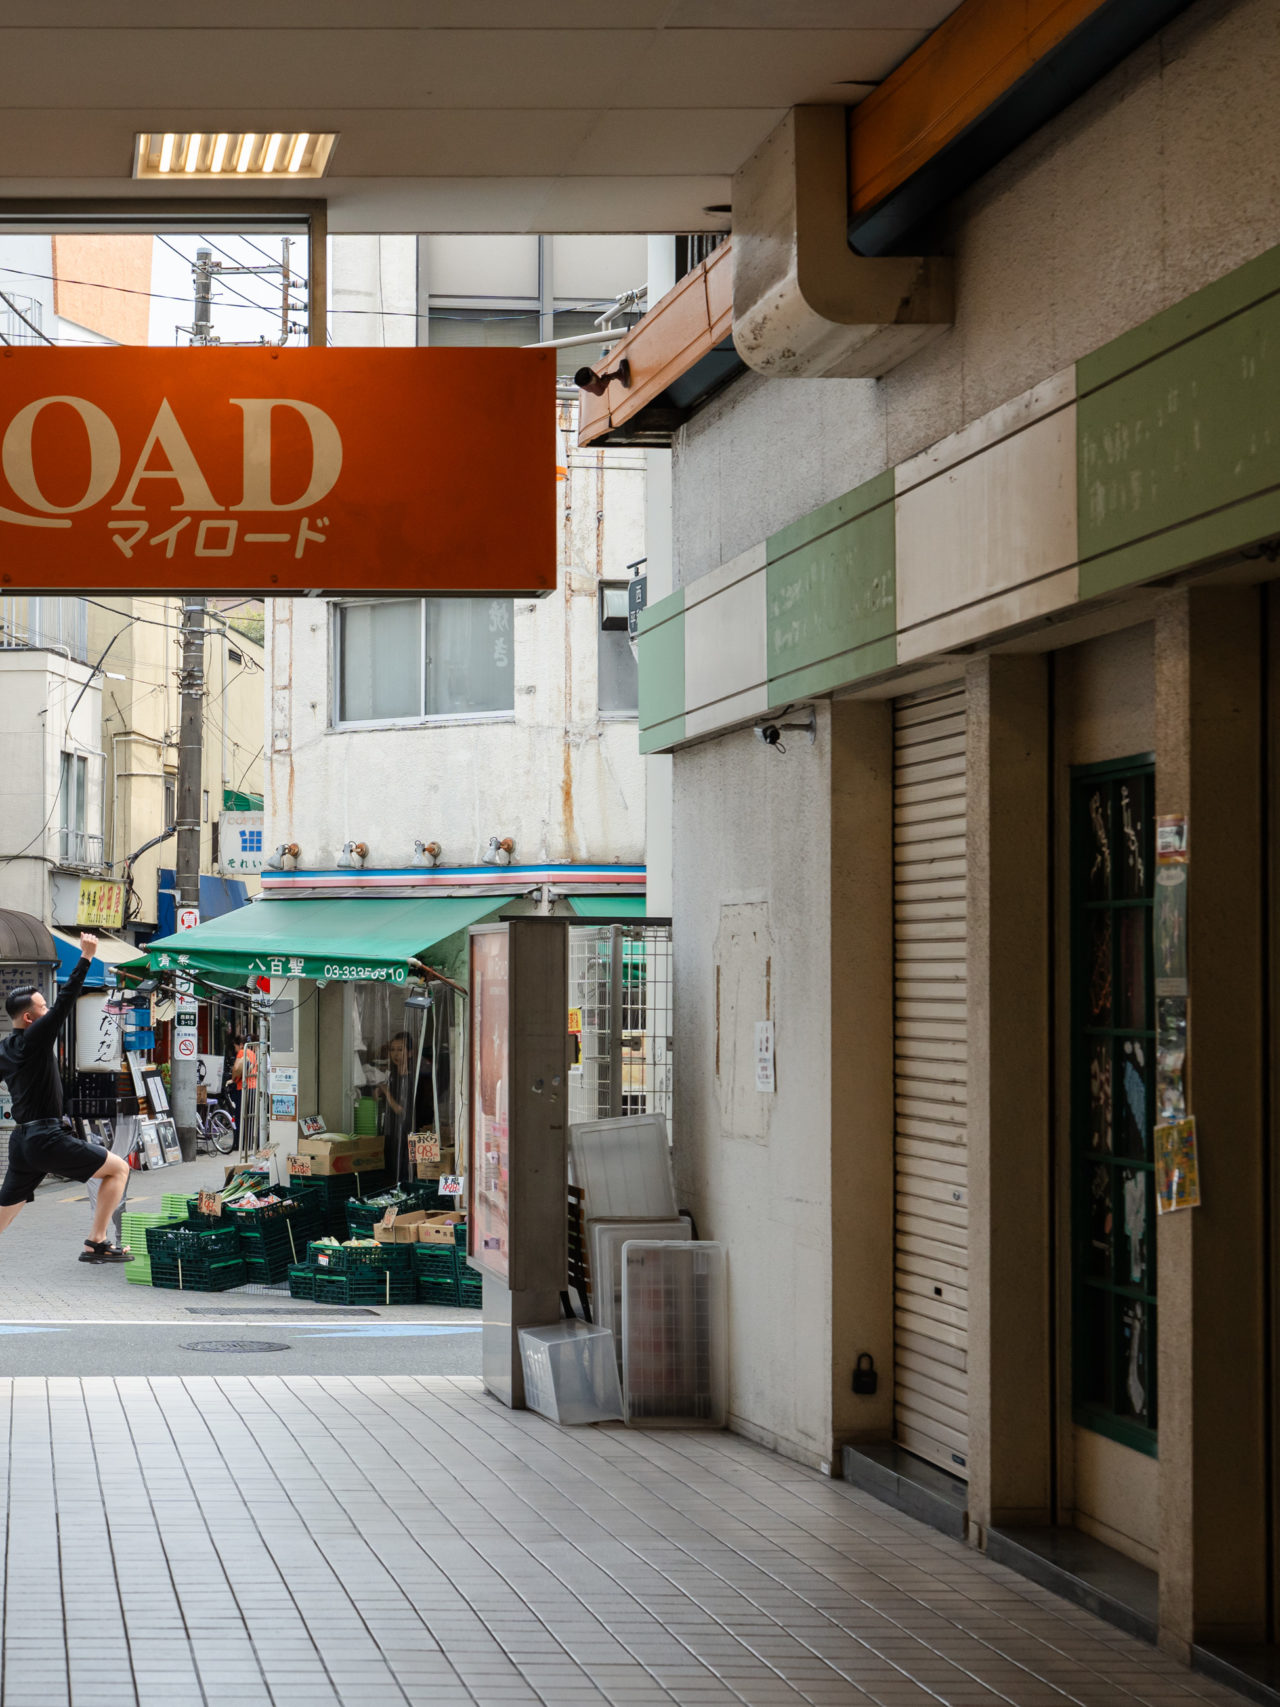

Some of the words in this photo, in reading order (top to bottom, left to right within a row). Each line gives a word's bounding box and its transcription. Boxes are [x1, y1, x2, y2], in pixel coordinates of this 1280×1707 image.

[108, 516, 330, 559] マイロード
[248, 956, 306, 977] 八百聖
